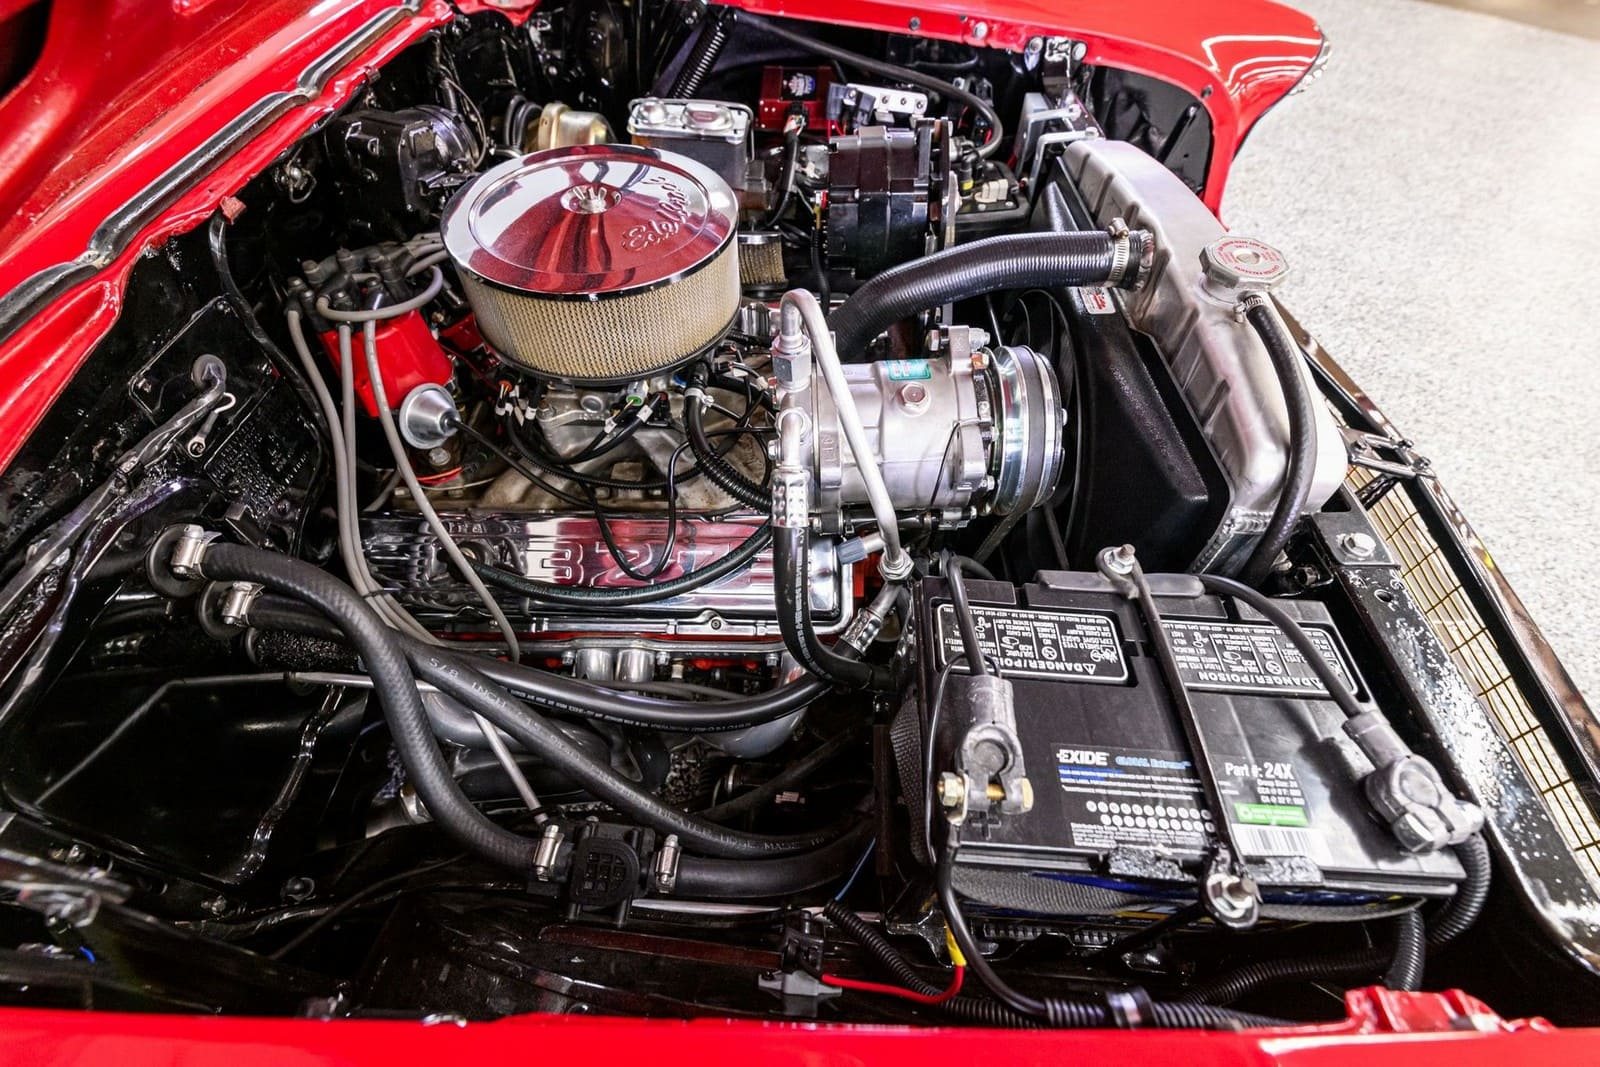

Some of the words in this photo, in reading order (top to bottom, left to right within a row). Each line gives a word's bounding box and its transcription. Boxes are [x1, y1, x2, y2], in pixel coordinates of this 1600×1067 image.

[427, 655, 460, 680] 5/8
[1056, 749, 1109, 766] EXIDE
[1225, 762, 1249, 777] Part
[1264, 762, 1295, 780] 24X
